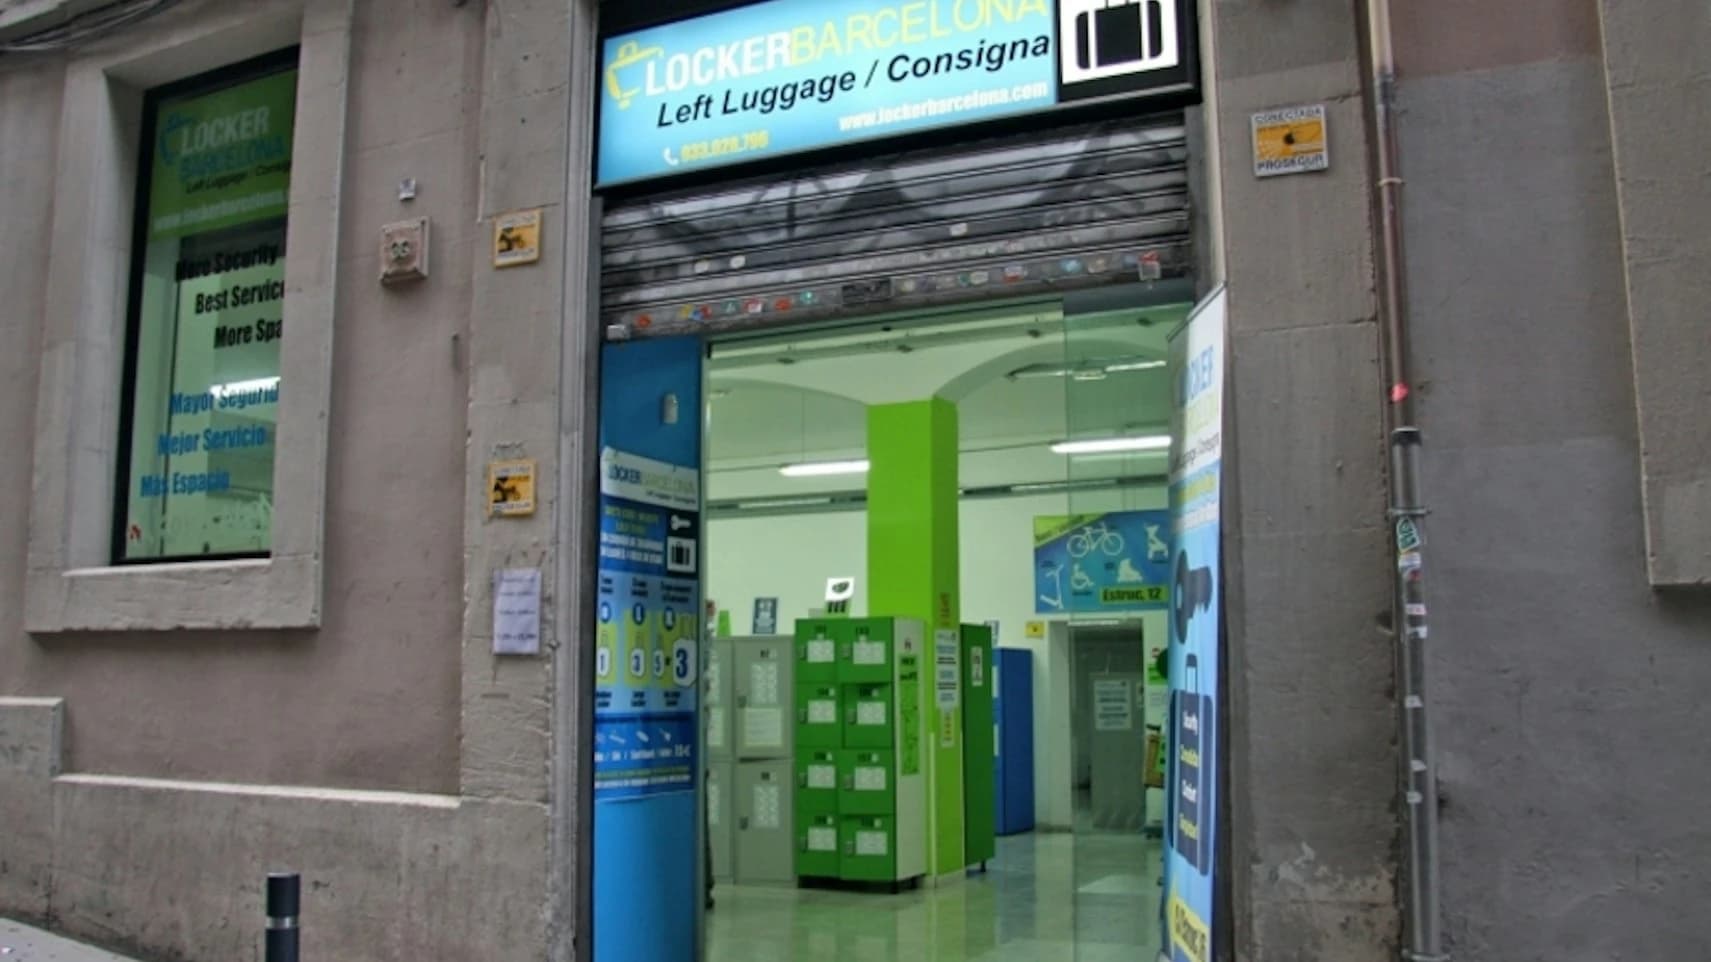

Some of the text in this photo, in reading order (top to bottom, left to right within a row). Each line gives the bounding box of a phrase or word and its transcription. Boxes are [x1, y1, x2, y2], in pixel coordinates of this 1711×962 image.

[657, 34, 1050, 128] Left Luggage / Consigna
[839, 81, 1048, 131] www.lockerbarcelona.com
[180, 106, 271, 156] LOCKER
[1257, 153, 1324, 170] PROSEGUR
[214, 243, 279, 273] Security
[195, 290, 228, 315] Best
[214, 325, 252, 350] More
[171, 392, 214, 416] Mayor
[157, 424, 267, 456] Mejor Servicio
[172, 467, 230, 494] Espacio
[675, 648, 688, 678] 3
